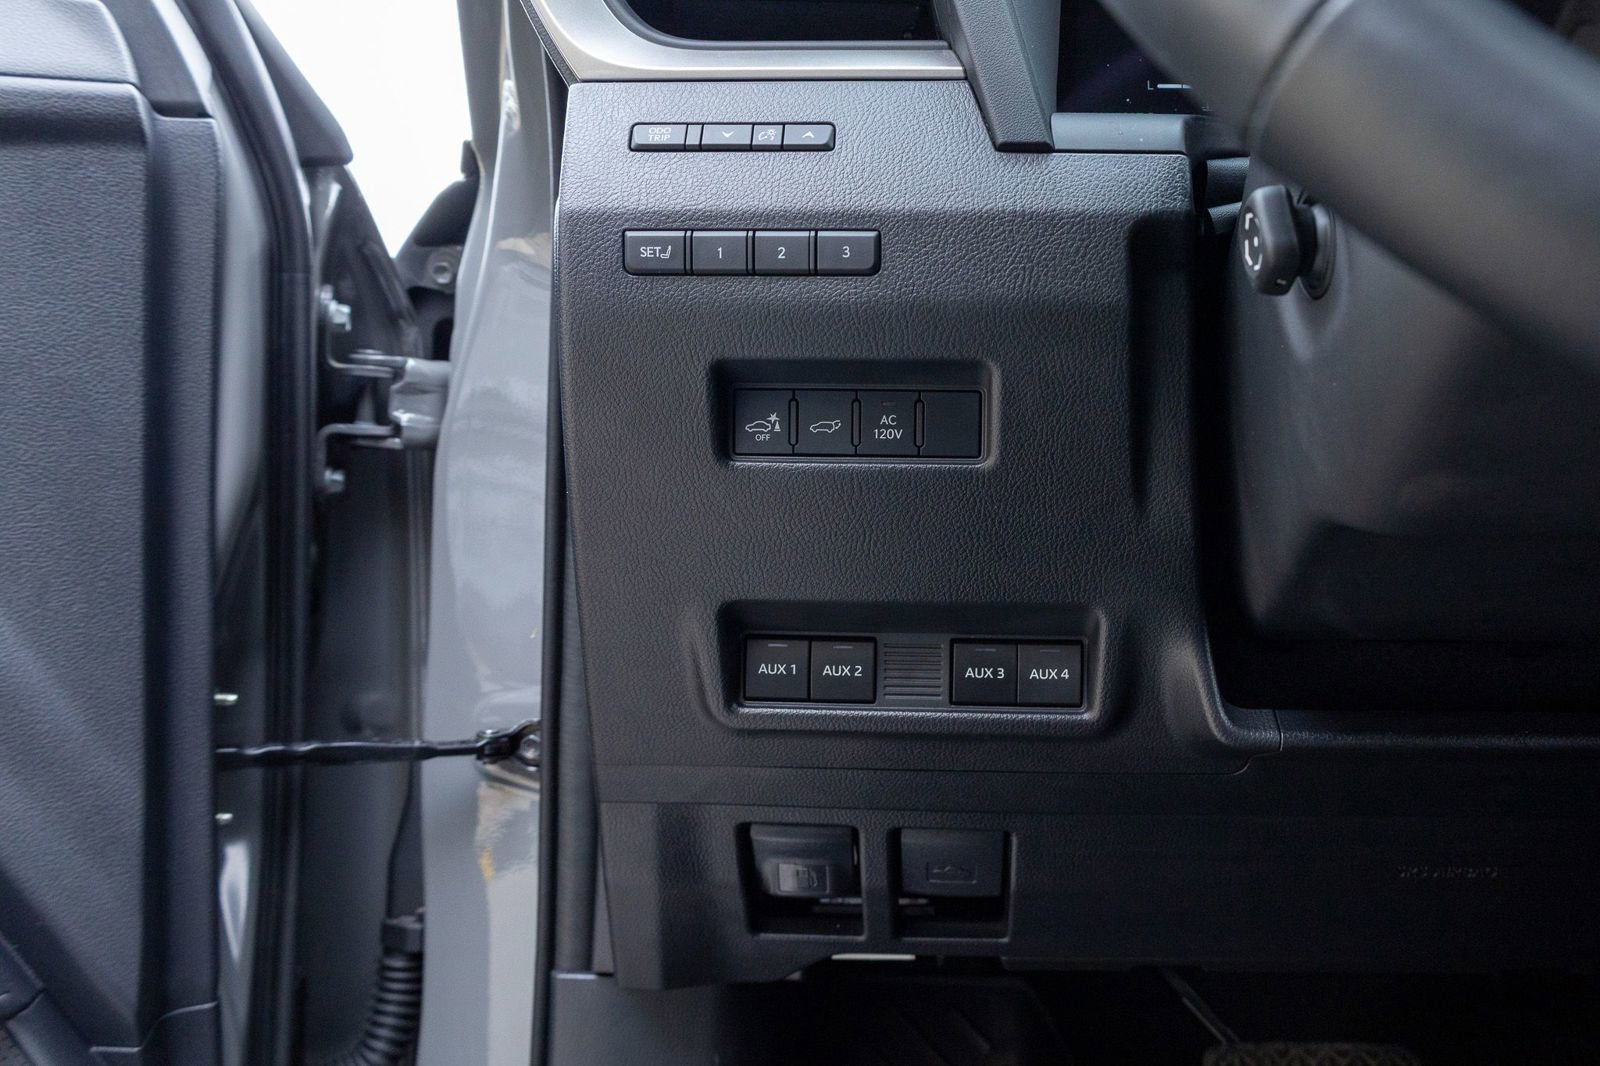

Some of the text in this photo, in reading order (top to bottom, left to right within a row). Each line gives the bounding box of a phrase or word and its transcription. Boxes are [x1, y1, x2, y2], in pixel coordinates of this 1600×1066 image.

[648, 134, 671, 142] TRIP
[640, 246, 661, 258] SET
[717, 247, 723, 259] 1
[777, 247, 786, 259] 2
[842, 246, 850, 258] 3
[880, 414, 897, 426] AC
[755, 433, 771, 442] OFF
[873, 428, 903, 440] 120V
[758, 663, 797, 675] AUX 1
[822, 665, 863, 677] AUX 2
[964, 667, 1005, 679] AUX 3
[1029, 668, 1070, 680] AUX 4
